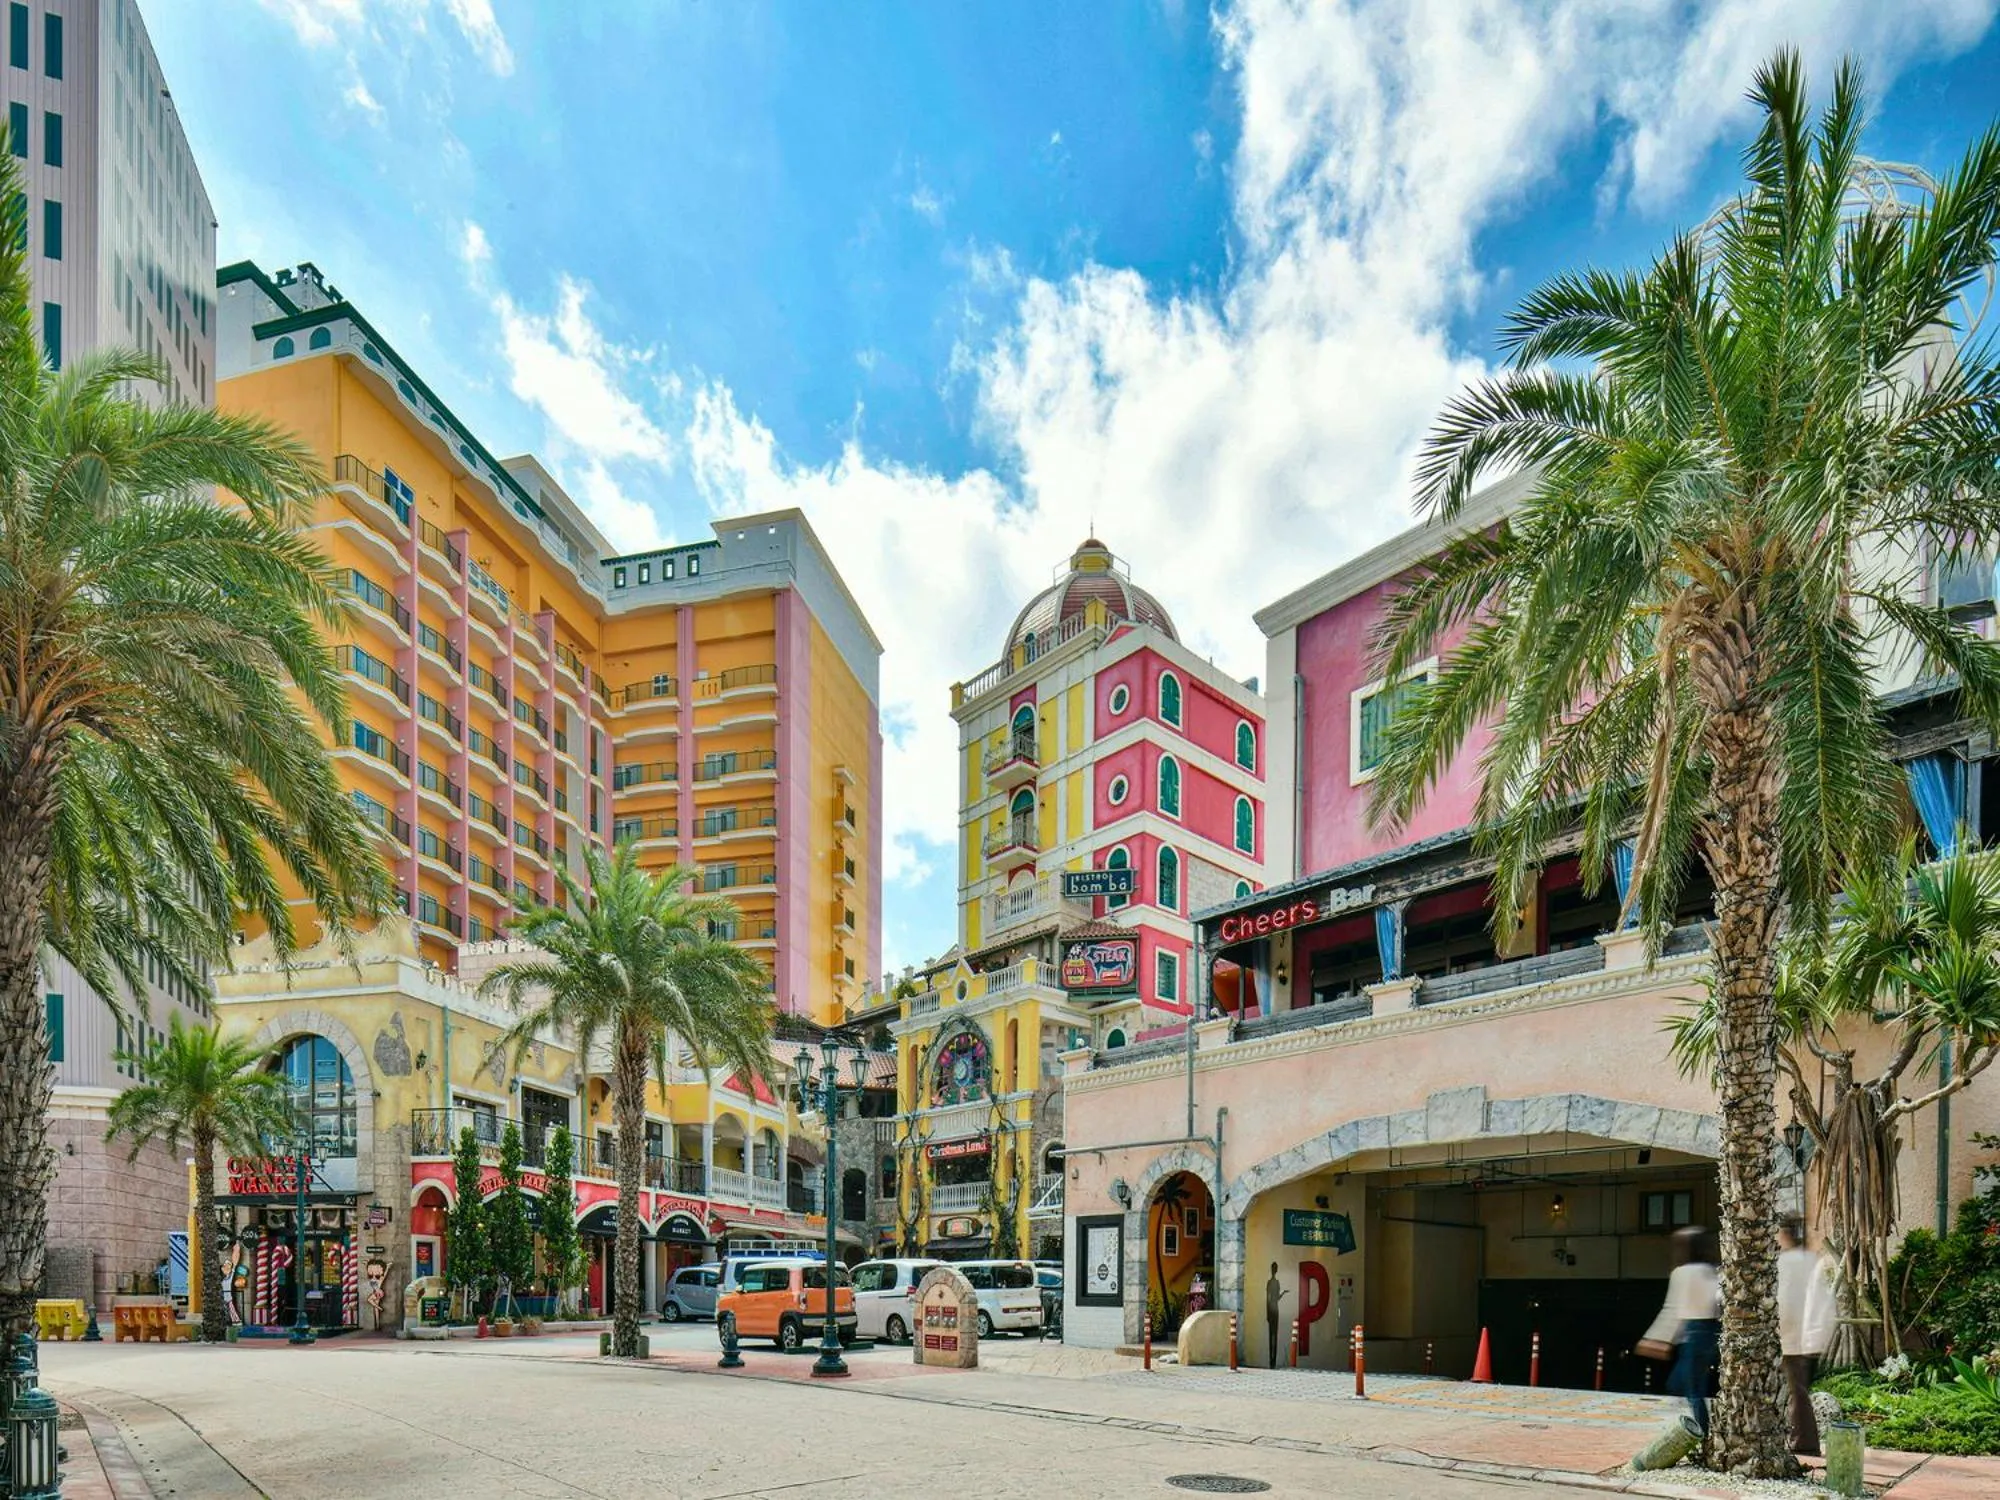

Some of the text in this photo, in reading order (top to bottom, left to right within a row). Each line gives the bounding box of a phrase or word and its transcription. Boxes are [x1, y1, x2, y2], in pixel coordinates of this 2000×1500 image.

[1071, 875, 1103, 893] bom
[1222, 884, 1376, 941] Cheers Bar
[1093, 950, 1127, 962] STEAK
[1298, 1261, 1330, 1356] P
